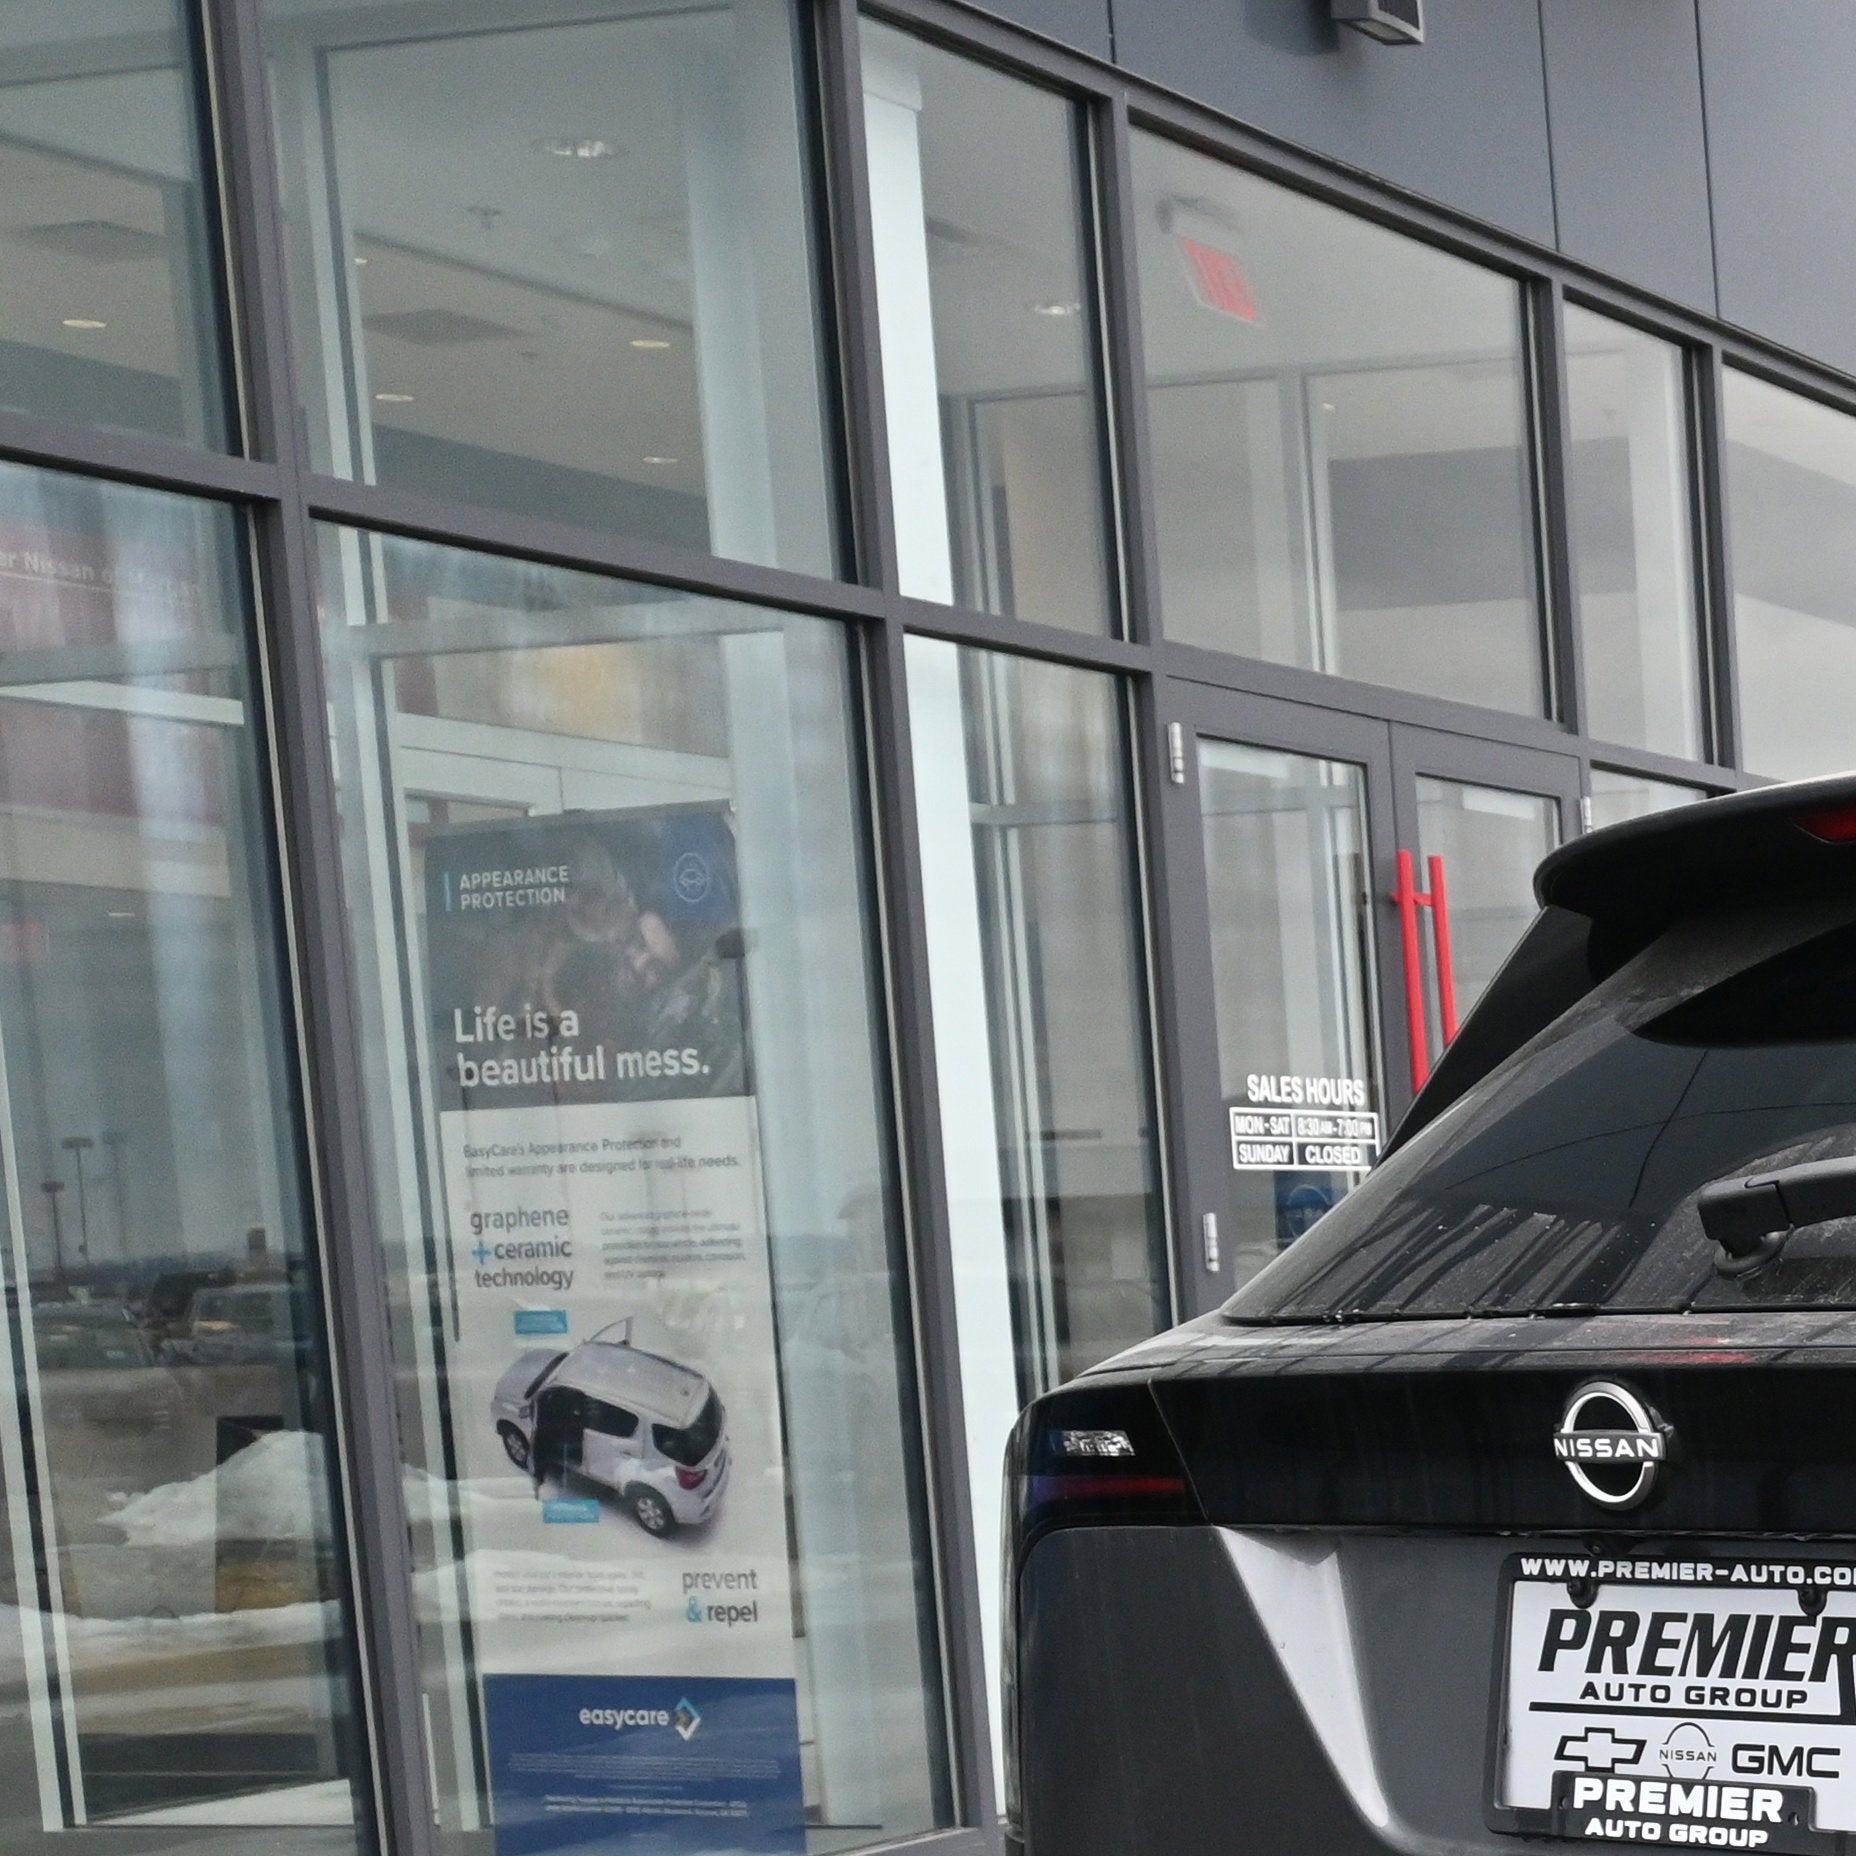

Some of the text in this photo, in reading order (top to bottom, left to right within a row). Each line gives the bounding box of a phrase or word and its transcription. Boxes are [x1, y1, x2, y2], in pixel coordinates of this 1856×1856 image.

[459, 865, 569, 891] APPEARANCE
[460, 887, 566, 911] PROTECTION
[454, 1003, 580, 1043] Life is a
[457, 1045, 710, 1087] beautiful mess.
[1247, 1074, 1366, 1106] SALES HOURS
[1238, 1143, 1361, 1165] SUNDAY CLOSED
[470, 1206, 570, 1236] graphene
[474, 1267, 575, 1291] technology
[1554, 1437, 1660, 1459] NISSAN
[682, 1568, 758, 1594] prevent
[685, 1595, 702, 1624] &
[707, 1600, 759, 1628] repel
[1579, 1681, 1809, 1709] AUTO GROUP
[578, 1706, 670, 1730] easycare
[1658, 1743, 1842, 1779] NISSAN GMC
[1573, 1777, 1784, 1823] PREMIER
[1584, 1817, 1769, 1848] AUTO GROUP
